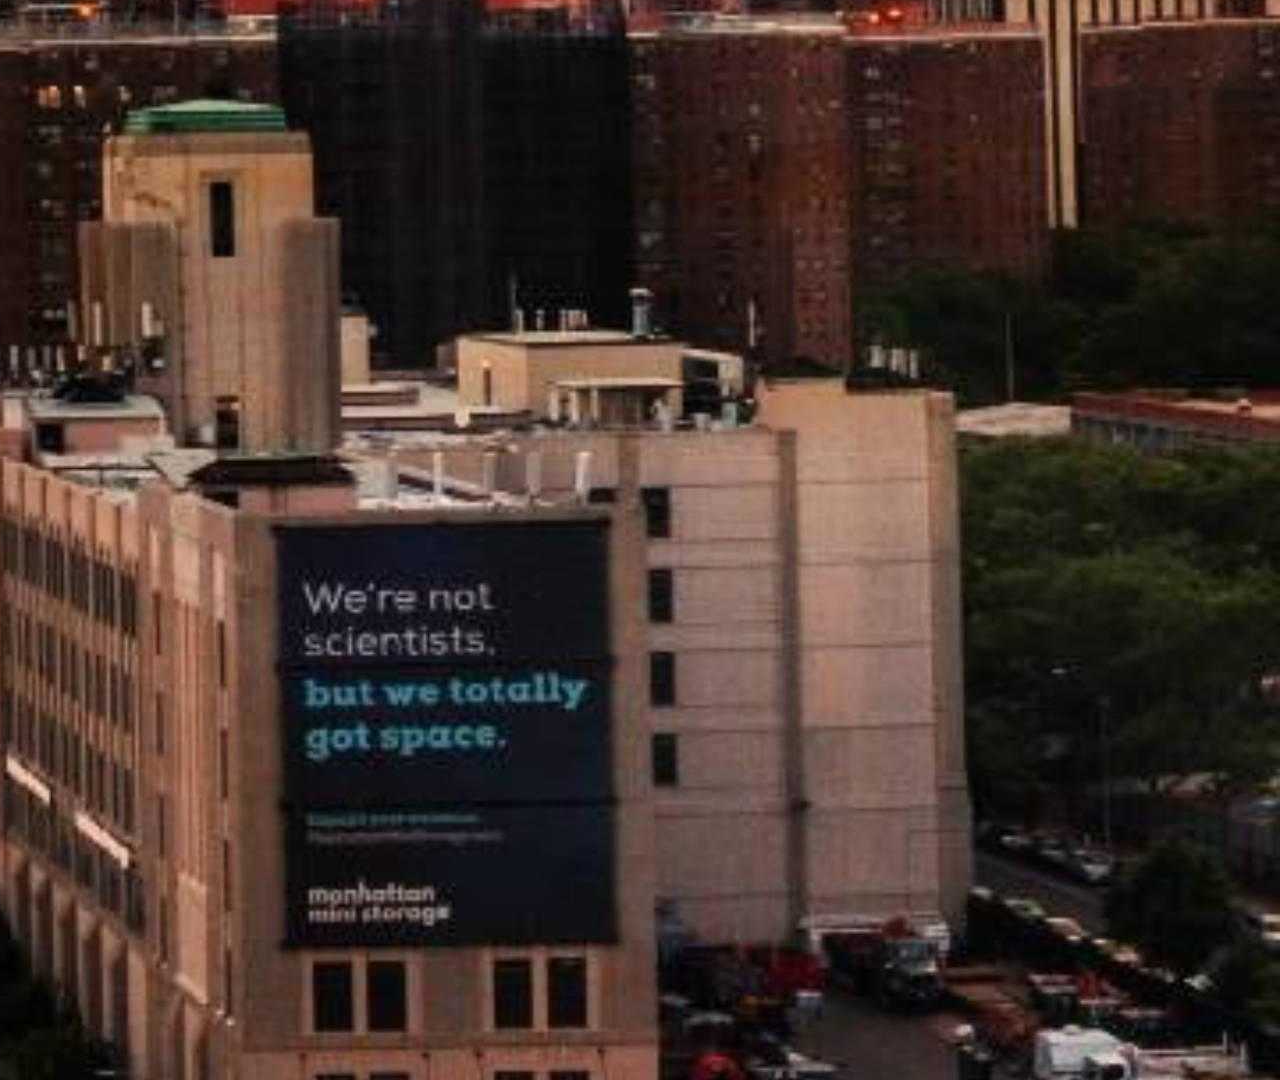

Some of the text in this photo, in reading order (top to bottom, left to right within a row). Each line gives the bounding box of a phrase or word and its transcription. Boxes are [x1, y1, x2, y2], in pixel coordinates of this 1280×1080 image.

[303, 582, 495, 614] We're not
[304, 672, 587, 708] but we totally
[306, 723, 506, 759] got space.
[308, 879, 435, 904] manhattan
[308, 905, 450, 926] mini storage
